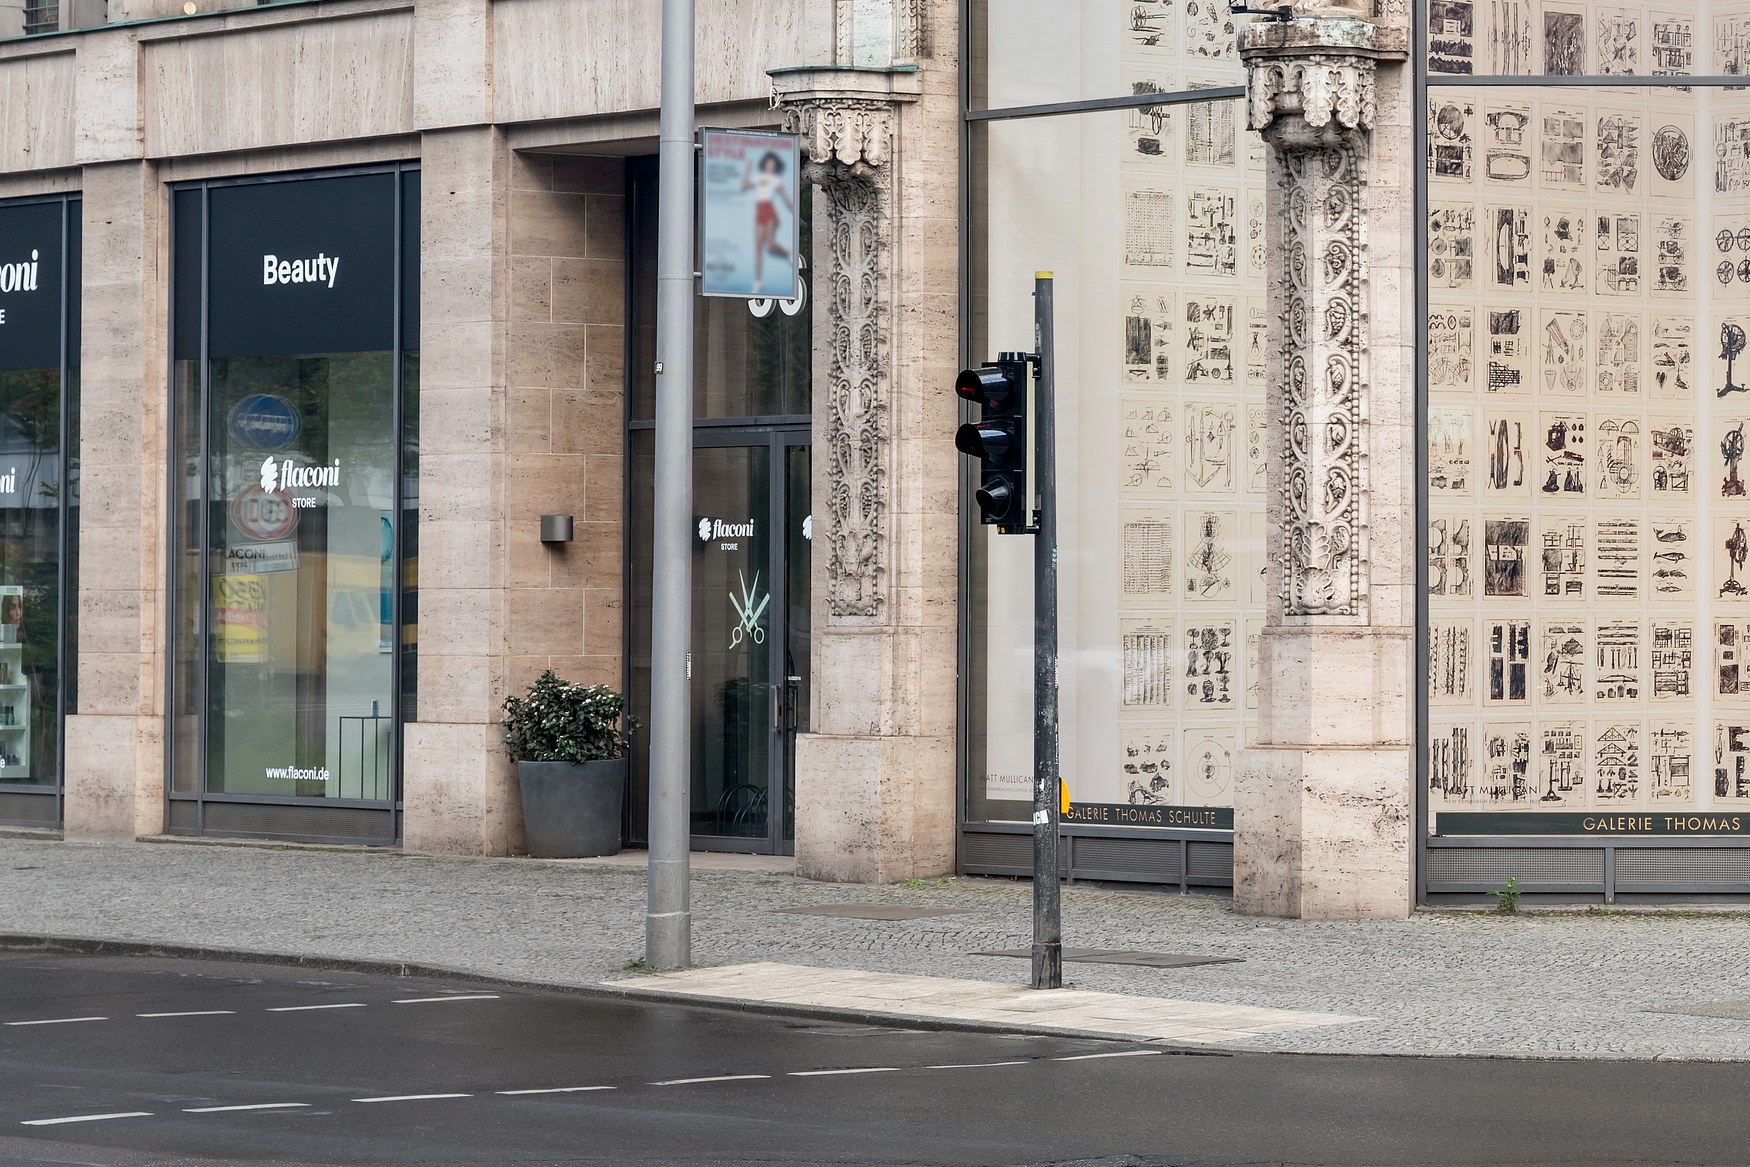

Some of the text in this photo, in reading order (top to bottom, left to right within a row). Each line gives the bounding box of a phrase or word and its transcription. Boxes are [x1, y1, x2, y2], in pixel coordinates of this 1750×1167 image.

[0, 248, 39, 292] oni
[263, 252, 340, 289] Beauty
[280, 457, 340, 491] flaconi
[291, 497, 317, 509] STORE
[712, 518, 755, 540] flaconi
[720, 542, 738, 551] STORE
[265, 765, 330, 781] www.flaconi.de
[999, 775, 1034, 784] MULLICAN
[1066, 806, 1216, 825] GALERIE THOMAS SCHULTE
[1583, 817, 1653, 831] GALERIE
[1665, 817, 1741, 831] THOMAS
